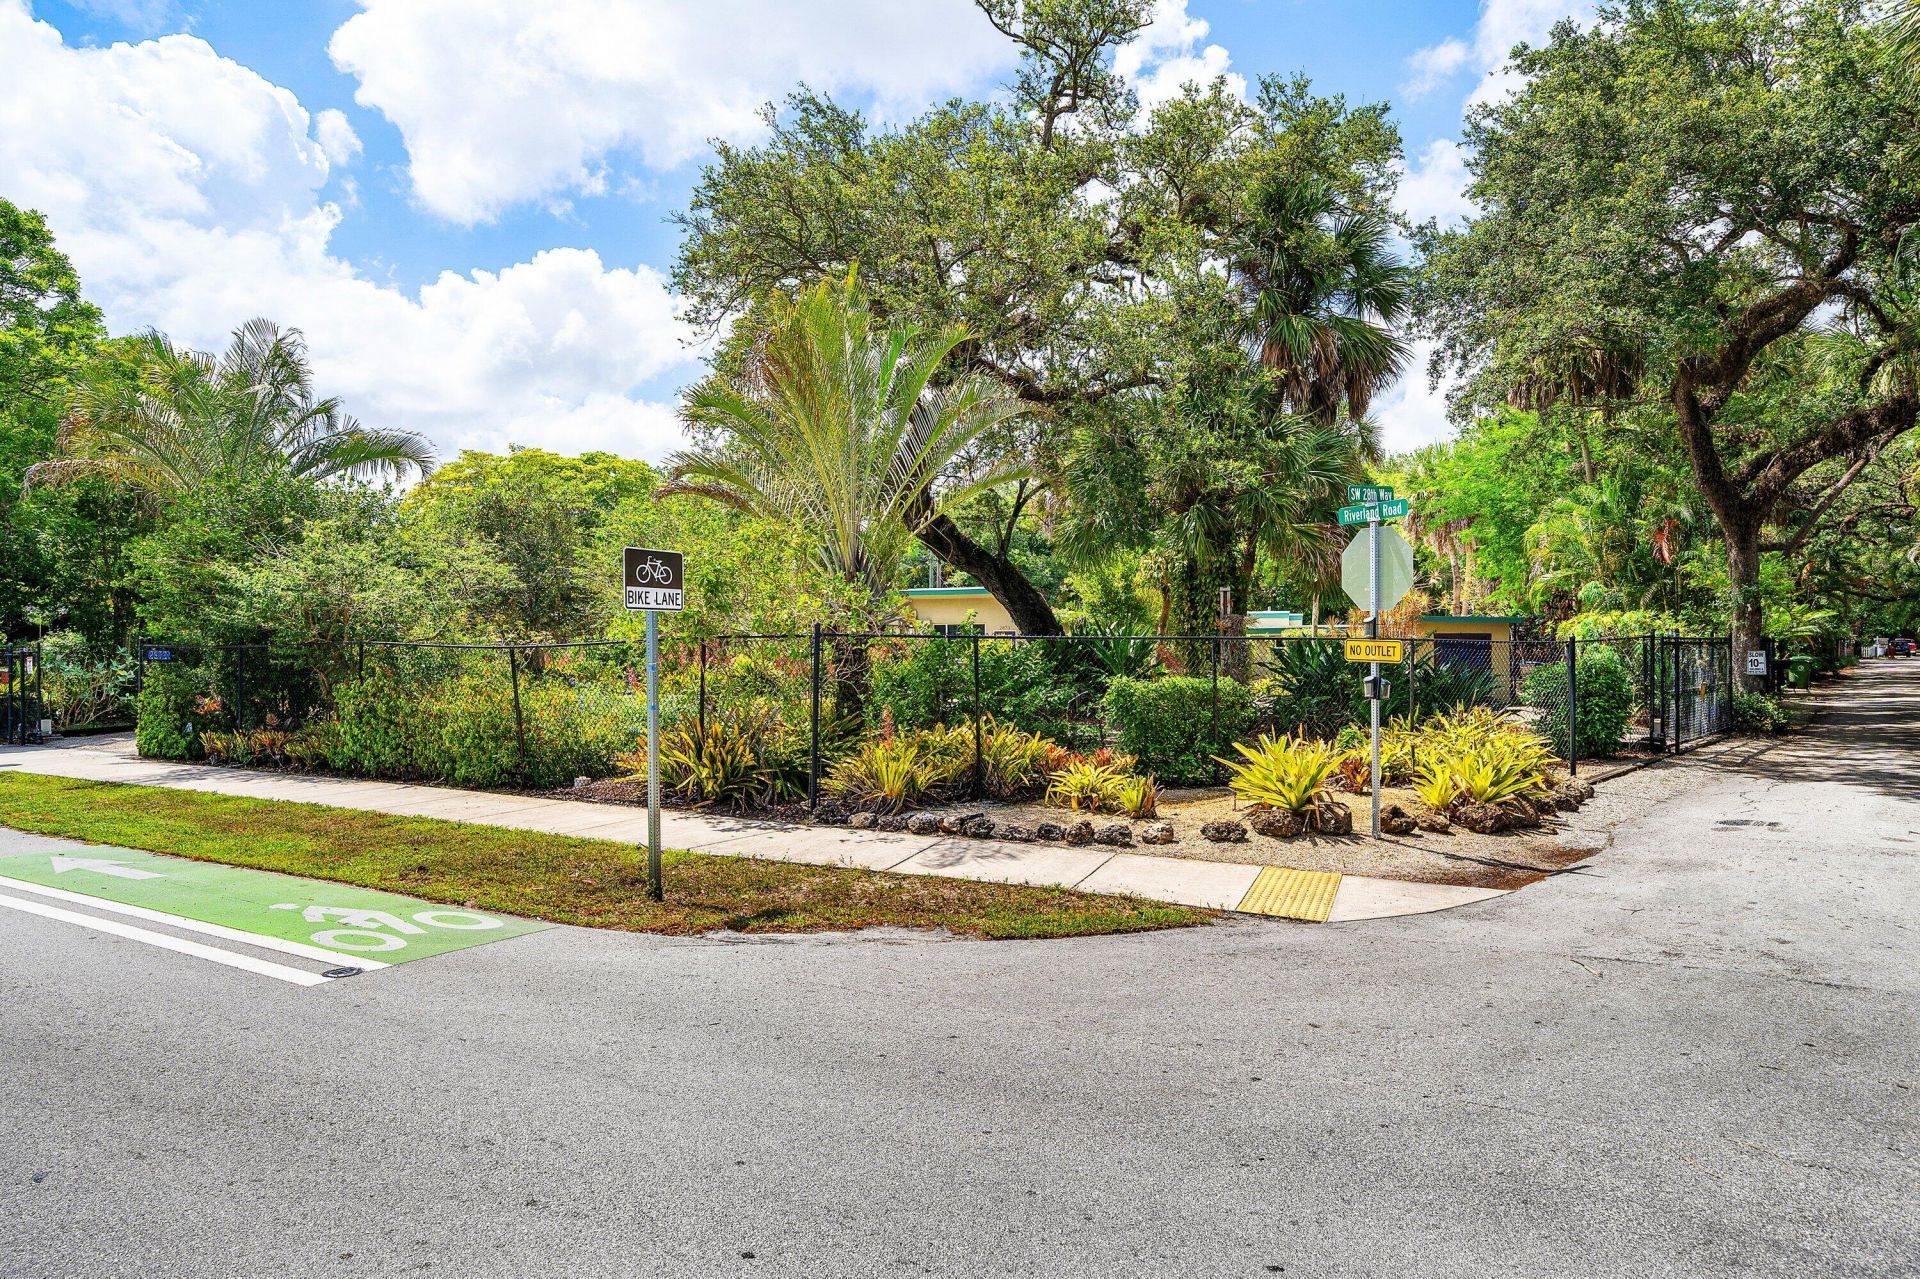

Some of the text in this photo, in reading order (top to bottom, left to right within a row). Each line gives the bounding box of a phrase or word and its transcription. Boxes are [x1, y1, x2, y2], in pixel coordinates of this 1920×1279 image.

[1350, 488, 1392, 501] SW 28th Way
[1344, 502, 1402, 522] Riverland Road
[627, 590, 681, 606] BIKE LANE
[1350, 645, 1397, 657] NO OUTLET
[1748, 659, 1759, 667] 10
